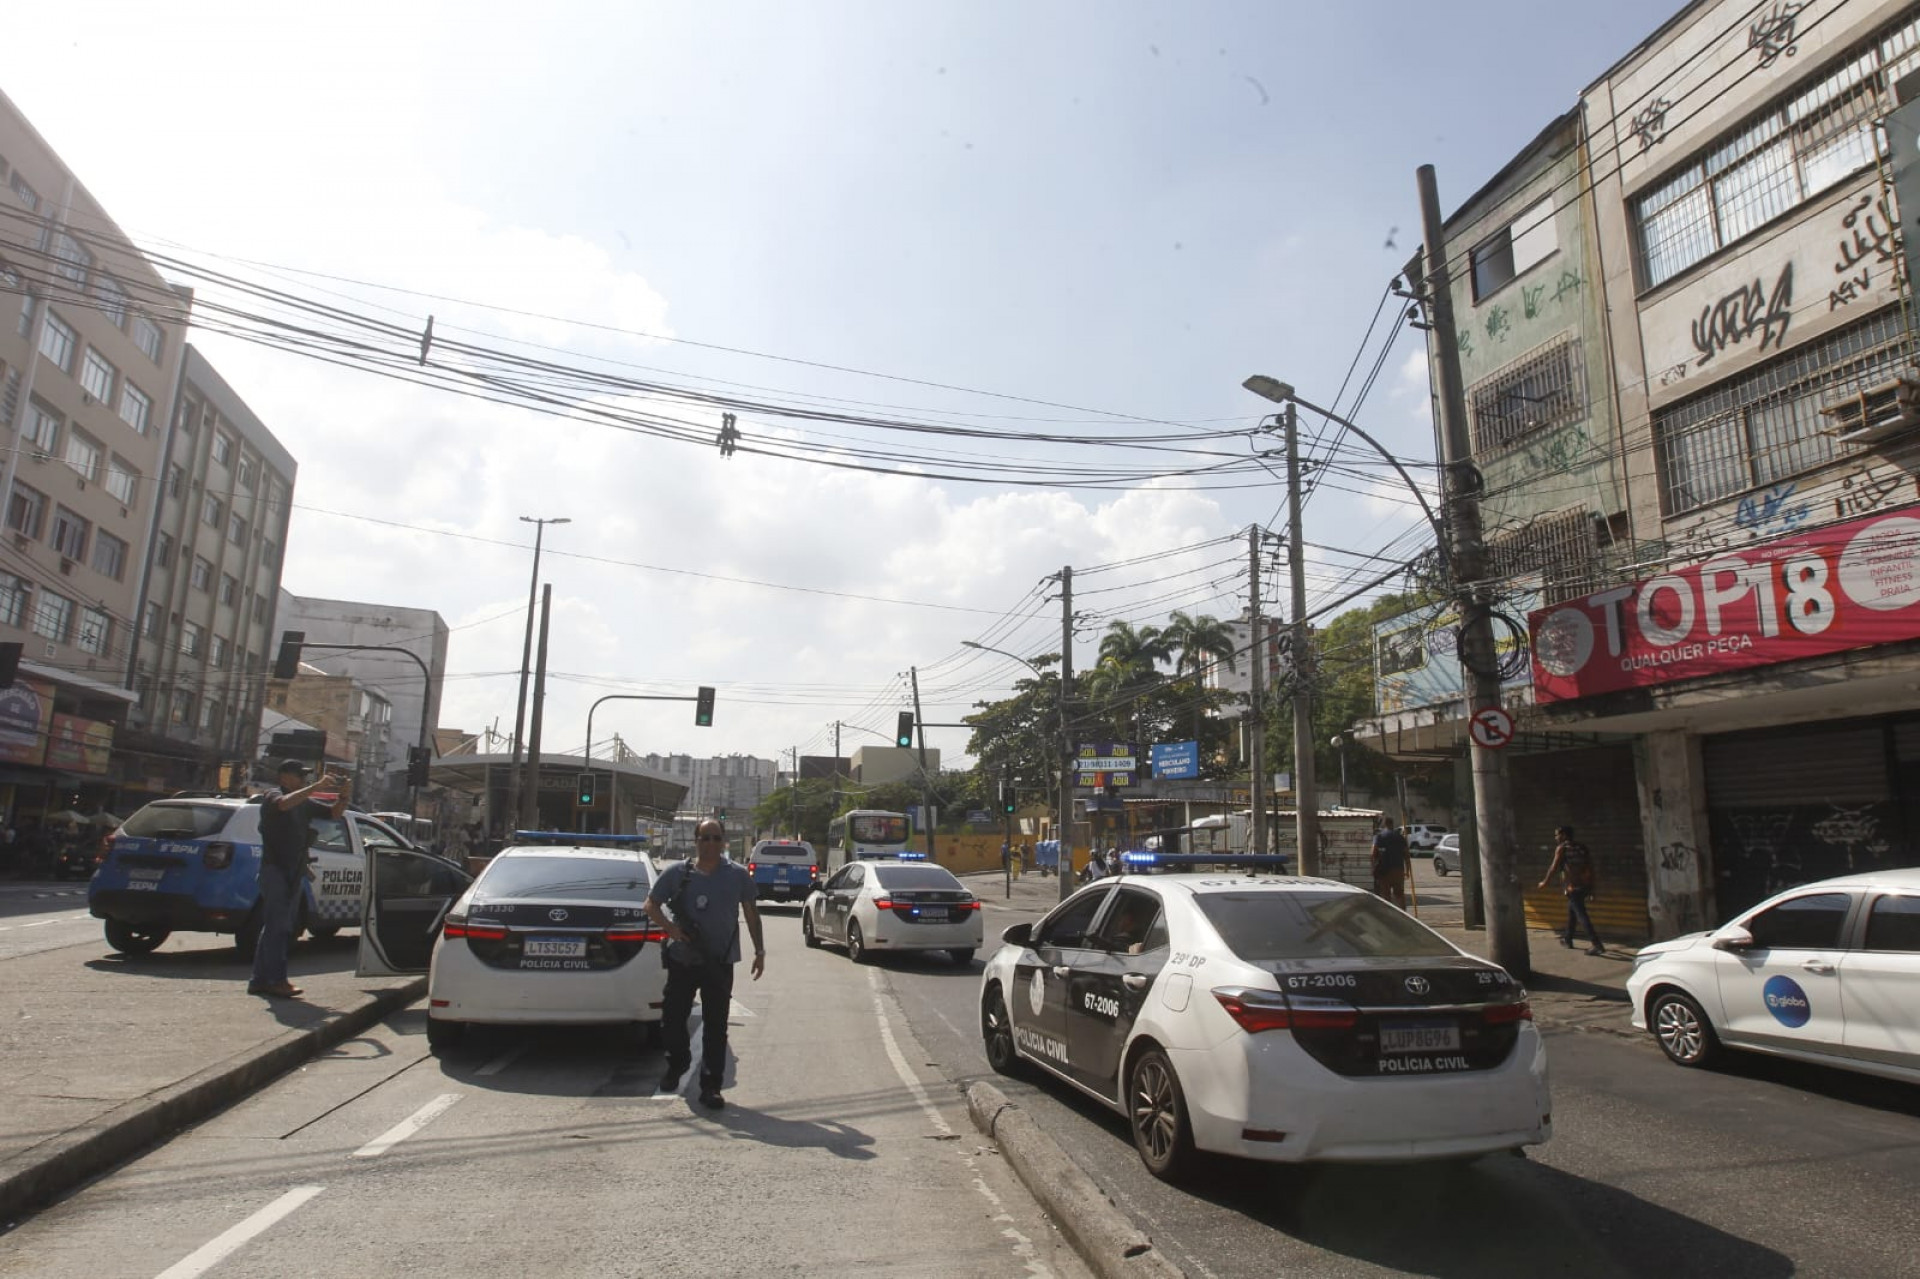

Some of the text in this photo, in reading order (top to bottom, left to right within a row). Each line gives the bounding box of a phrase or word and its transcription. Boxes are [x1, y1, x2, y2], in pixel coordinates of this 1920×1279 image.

[1870, 561, 1915, 577] INFANTIL
[1875, 572, 1913, 587] FITNESS
[1880, 584, 1911, 597] PRAIA
[1621, 633, 1753, 672] QUALQUER PEÇA
[322, 867, 363, 883] POLÍCIA
[321, 883, 361, 896] MILITAR
[520, 957, 590, 969] POLÍCIA CIVIL
[1188, 954, 1206, 969] DP
[1287, 975, 1357, 989] 67-2006
[1084, 992, 1119, 1019] 67-2006
[1779, 995, 1806, 1008] globo
[1014, 1026, 1069, 1065] POLÍCIA CIVIL
[1378, 1056, 1470, 1073] POLÍCIA CIVIL
